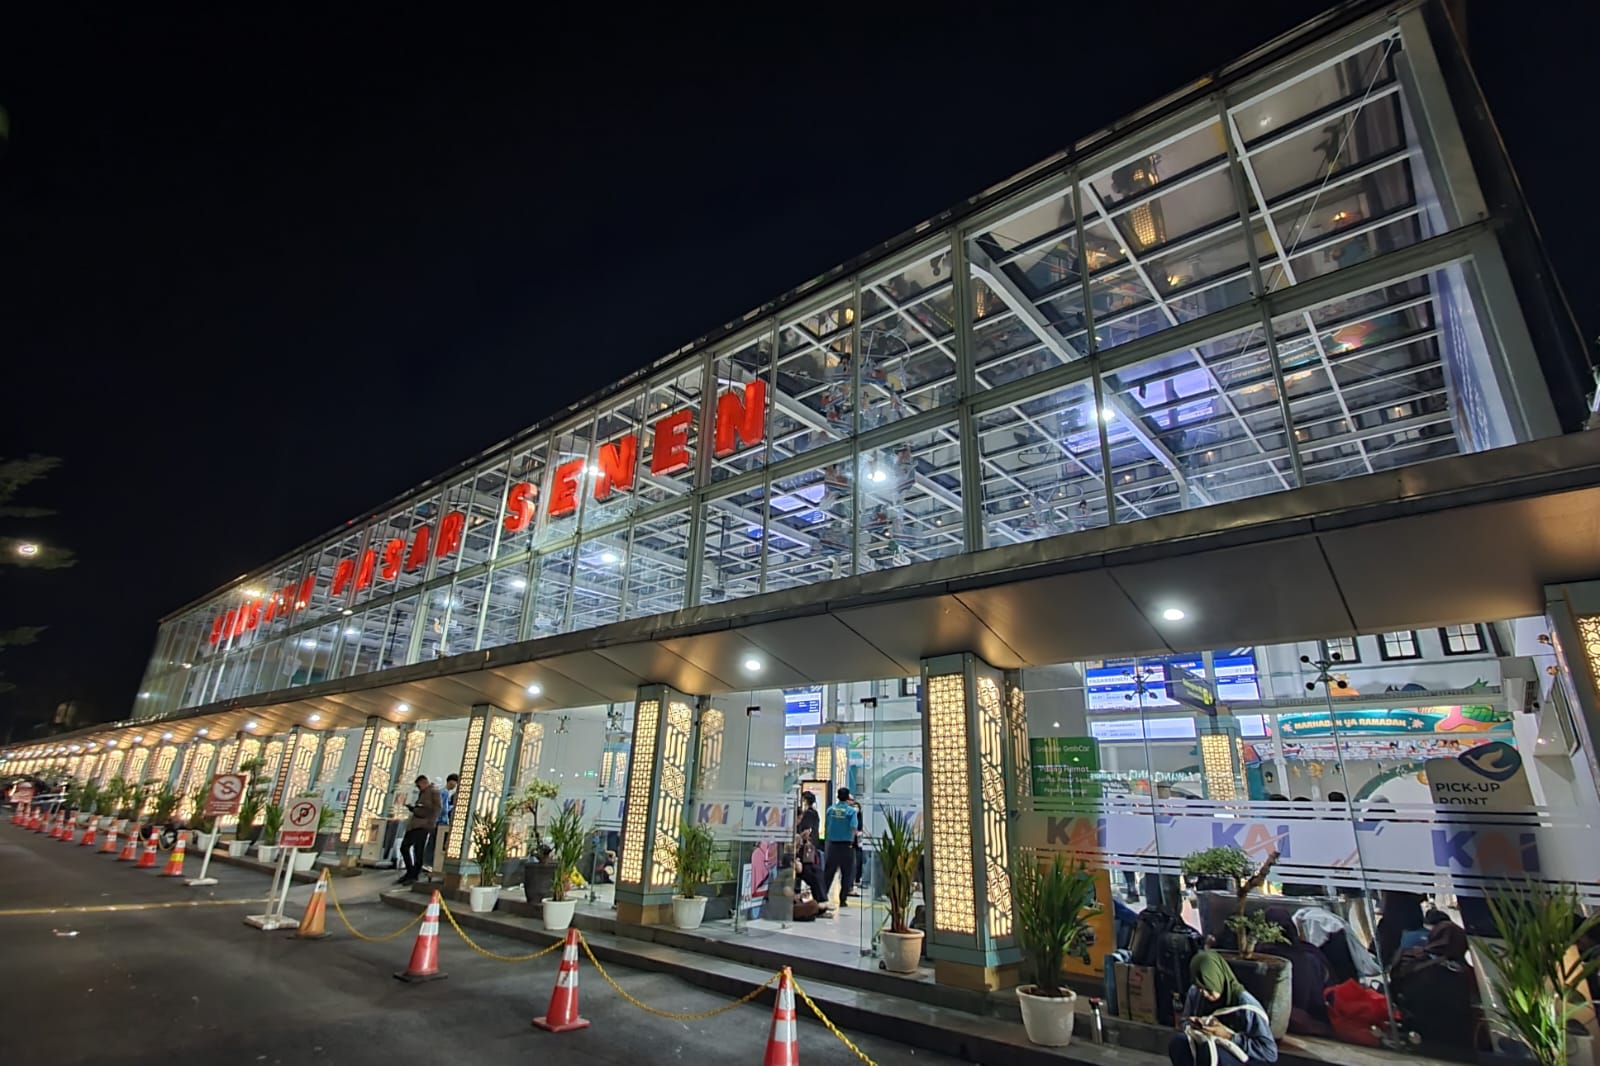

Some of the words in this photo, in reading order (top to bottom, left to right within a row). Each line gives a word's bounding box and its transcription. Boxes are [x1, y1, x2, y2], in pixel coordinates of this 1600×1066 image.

[332, 511, 465, 597] PASAR
[505, 378, 766, 533] SENEN
[1435, 782, 1500, 793] PICK-UP
[698, 803, 729, 825] KAI
[755, 805, 787, 827] KAI
[1047, 816, 1107, 849] KAI
[1212, 821, 1292, 859] KAI
[1430, 829, 1541, 873] KAI
